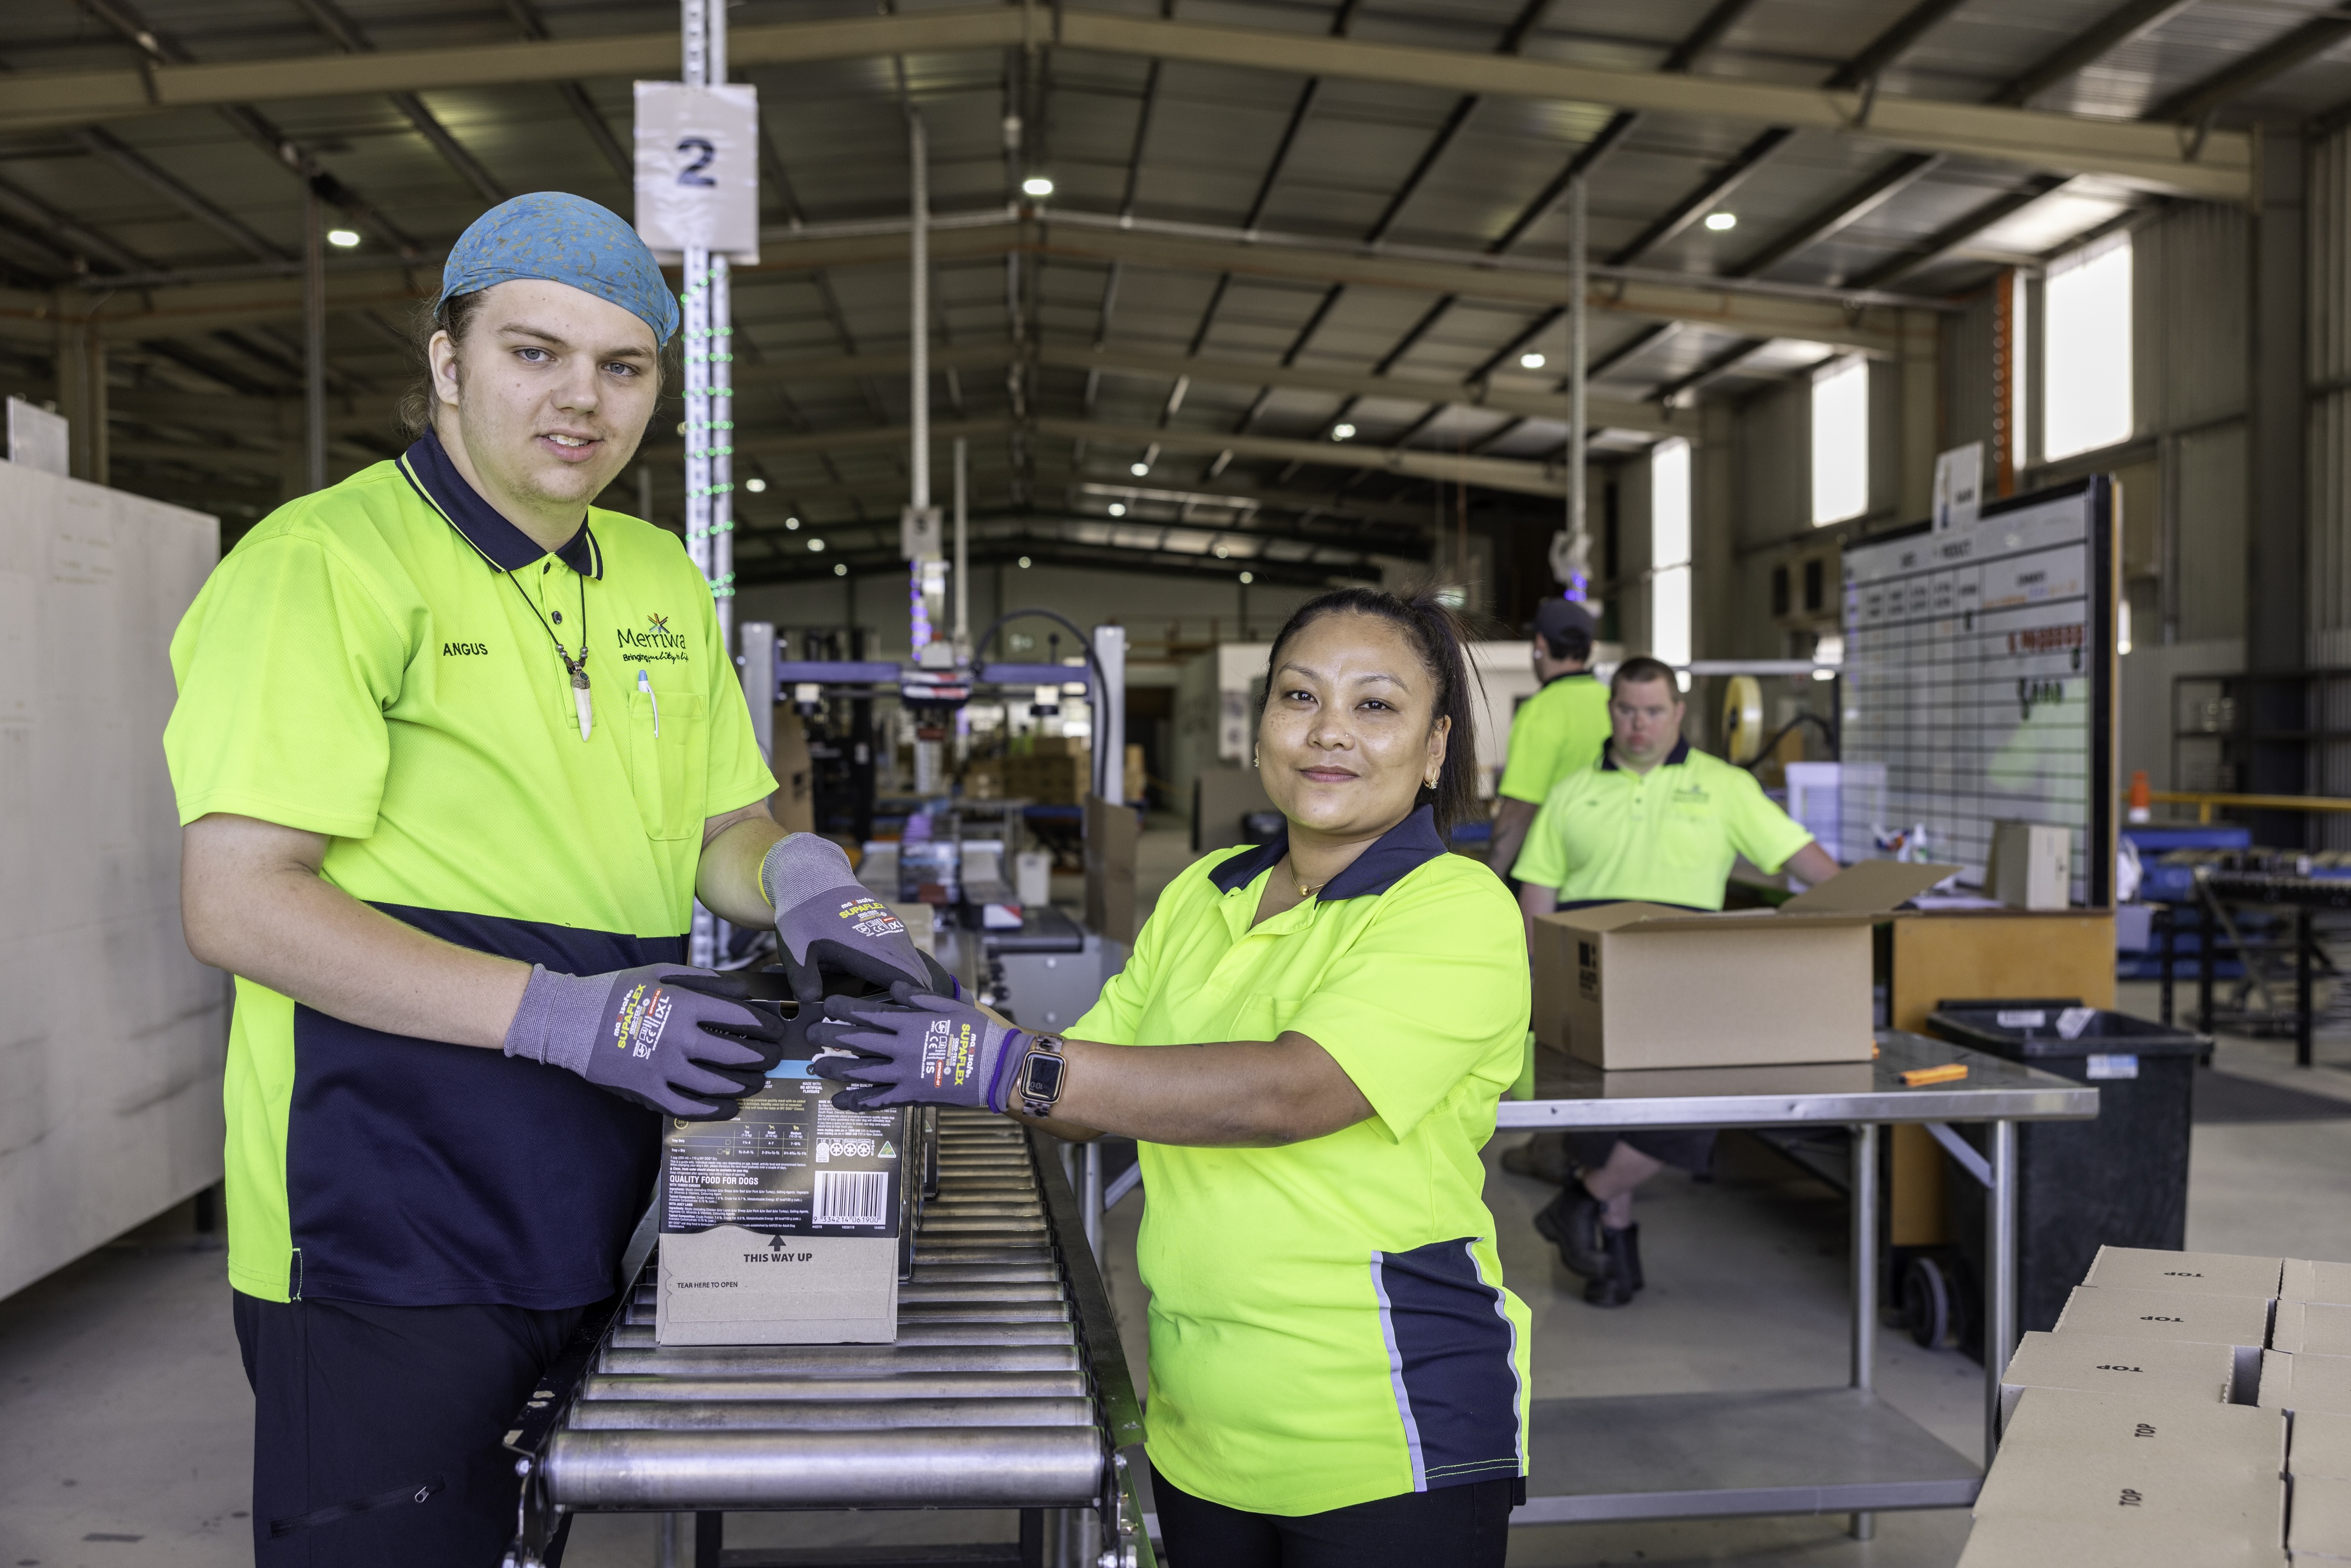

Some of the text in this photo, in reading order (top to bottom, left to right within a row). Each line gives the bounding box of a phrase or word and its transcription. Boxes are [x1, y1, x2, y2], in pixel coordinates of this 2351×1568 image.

[677, 137, 716, 188] 2
[617, 629, 686, 649] Merriwa
[443, 643, 488, 656] ANGUS
[839, 902, 885, 918] SUPAFLEX
[618, 983, 646, 1049] SUPAFLEX
[955, 1023, 971, 1086] SUPAFLEX
[670, 1175, 699, 1184] QUALITY
[743, 1253, 813, 1263] THIS WAY UP
[2134, 1423, 2157, 1437] TOP
[2118, 1488, 2143, 1506] TOP
